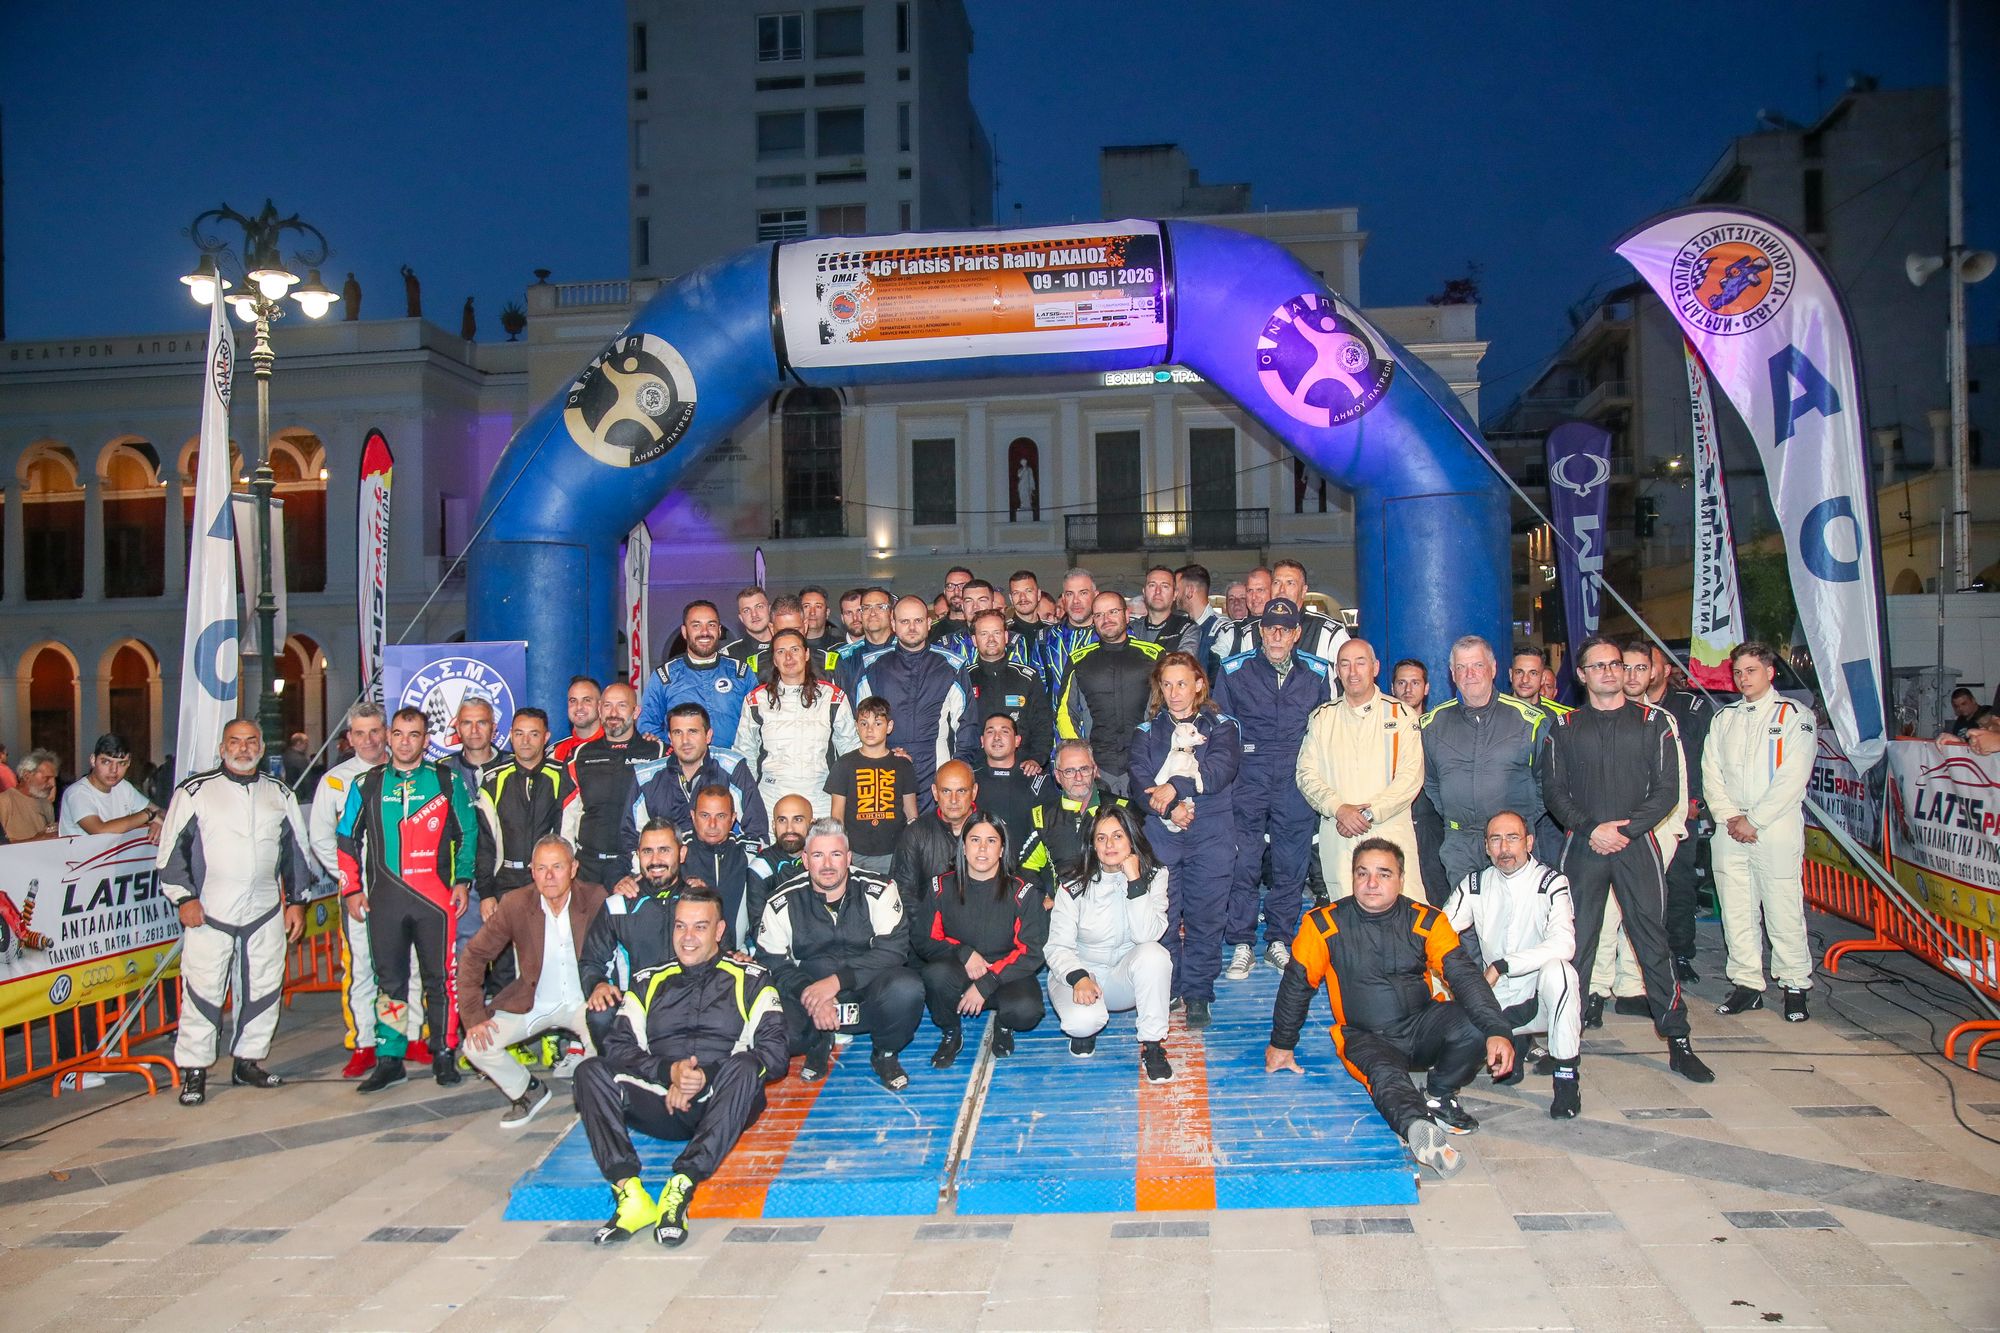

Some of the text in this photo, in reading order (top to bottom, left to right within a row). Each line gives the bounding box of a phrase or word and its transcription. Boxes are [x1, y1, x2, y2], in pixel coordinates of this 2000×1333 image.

[900, 257, 950, 275] Latsis
[954, 254, 999, 272] Parts
[1003, 251, 1046, 269] Rally
[1049, 247, 1107, 266] ΑΧΑΙΟΣ
[1033, 274, 1052, 290] 09
[1063, 272, 1079, 288] 10
[1089, 270, 1108, 287] 05
[1118, 268, 1155, 285] 2026
[137, 337, 241, 355] ΑΠΟΛΛΝ
[1333, 400, 1366, 423] ΔΗΜΟΥ
[1367, 360, 1393, 401] ΠΑΤΡΕΩΝ
[634, 402, 695, 463] ΔΗΜΟΥ ΠΑΤΡΕΩΝ
[1768, 726, 1782, 735] OMP
[856, 768, 875, 813] NEW
[880, 768, 896, 812] YORK
[1812, 766, 1834, 793] SIS
[412, 794, 448, 824] SINGER
[1914, 788, 1983, 834] LATSIS
[62, 903, 160, 942] ΑΝΤΑΛΛΑΚΤΙΚΑ
[48, 946, 85, 965] ΓΛΑΥΚΟΥ
[105, 934, 131, 951] ΠΑΤΡΑ
